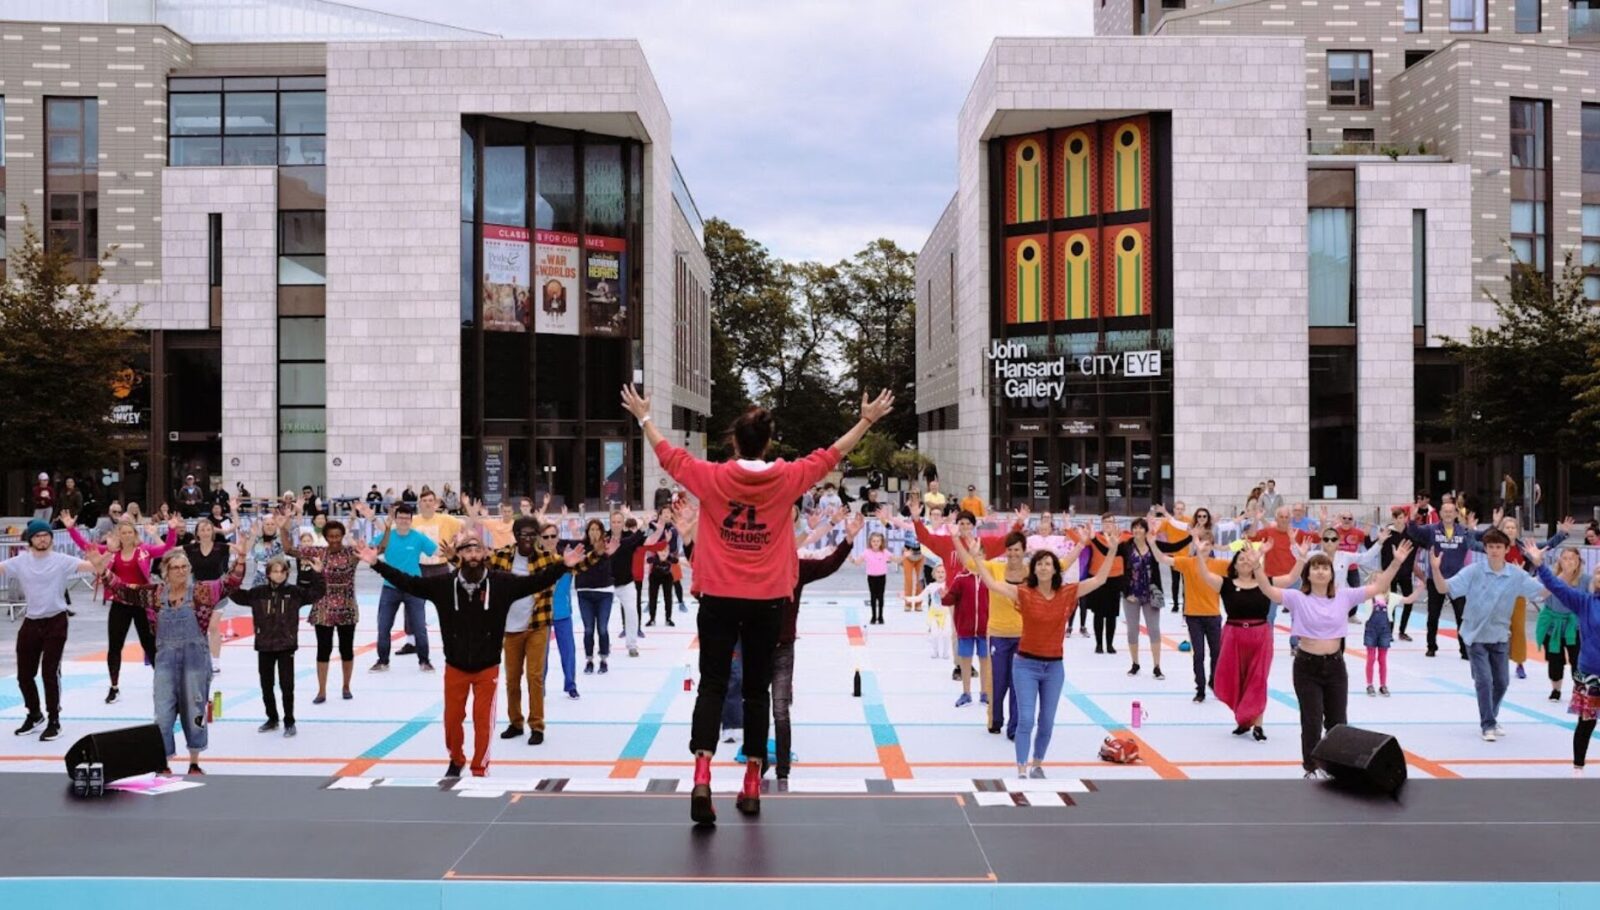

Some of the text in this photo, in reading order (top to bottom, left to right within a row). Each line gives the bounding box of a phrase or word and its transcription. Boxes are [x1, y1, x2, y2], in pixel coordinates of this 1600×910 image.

[498, 229, 605, 248] CLASSIS FOR OUR IMES
[547, 254, 567, 266] WAR
[540, 266, 576, 279] WORLDS
[988, 340, 1028, 360] John
[995, 357, 1065, 379] Hansard
[1080, 352, 1159, 376] CITY EYE
[1005, 379, 1065, 401] Gallery
